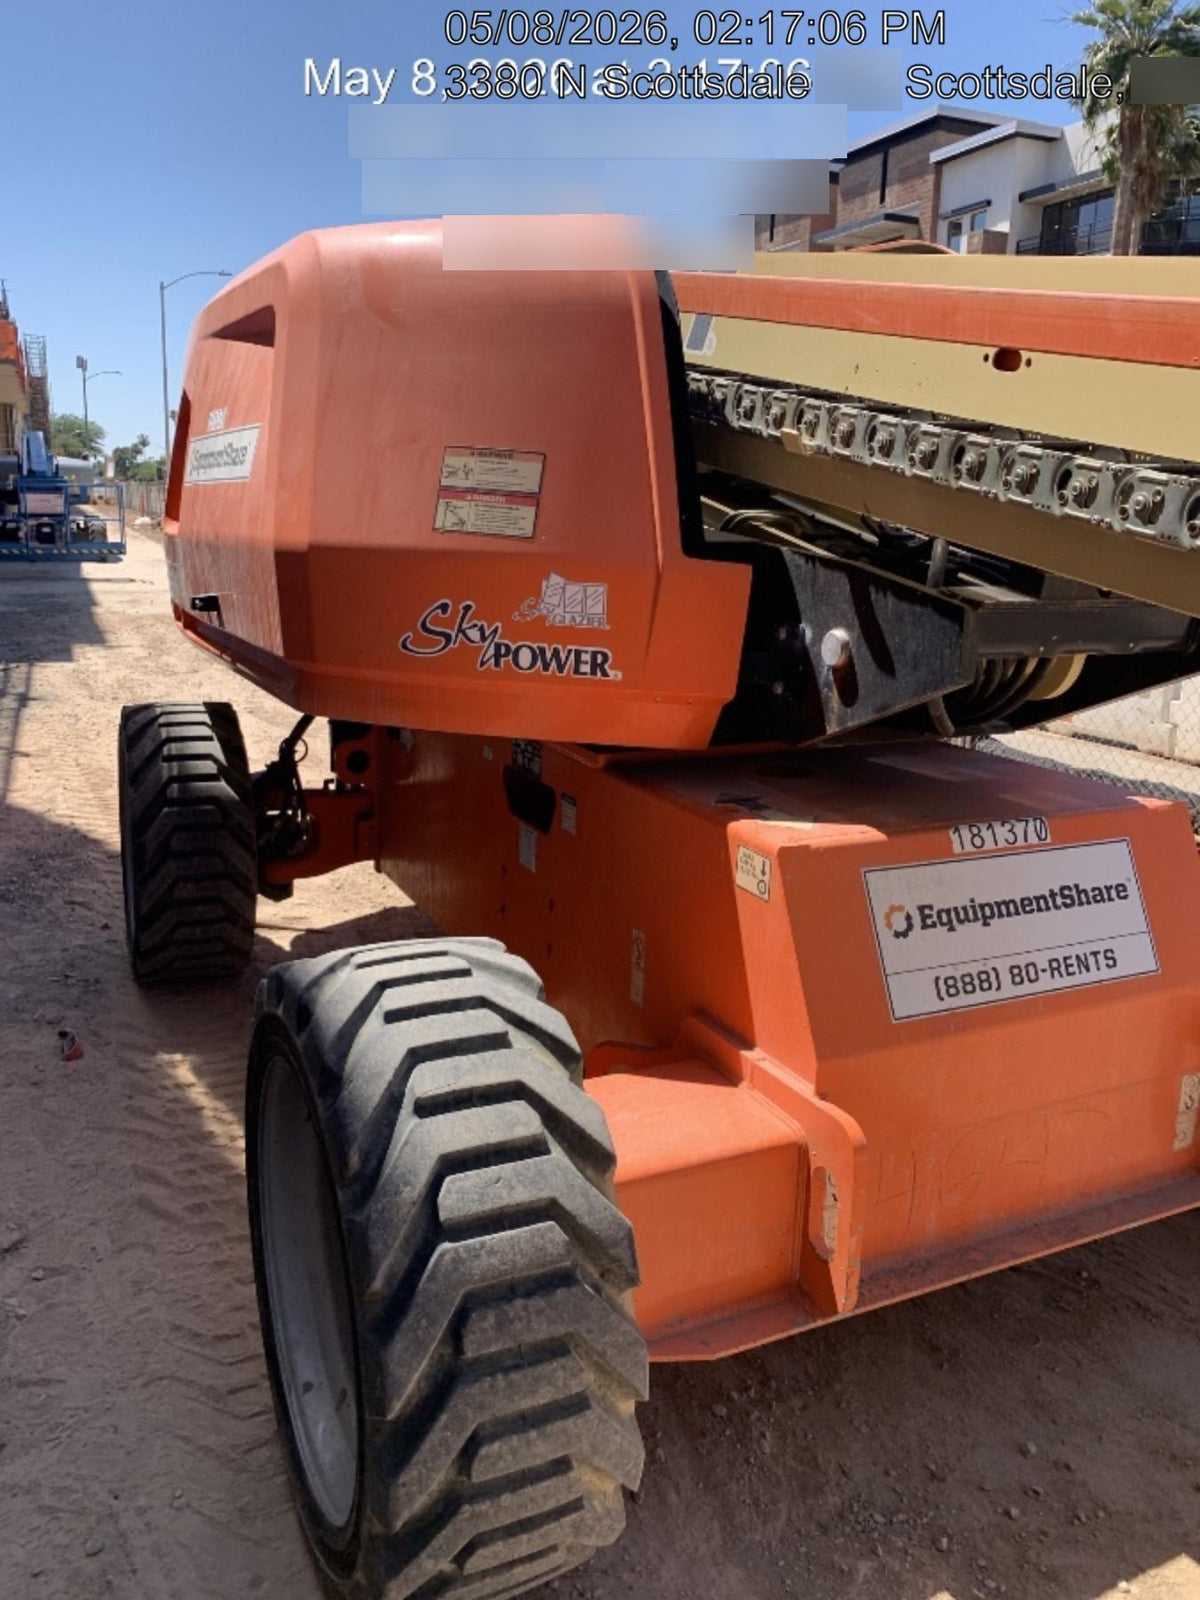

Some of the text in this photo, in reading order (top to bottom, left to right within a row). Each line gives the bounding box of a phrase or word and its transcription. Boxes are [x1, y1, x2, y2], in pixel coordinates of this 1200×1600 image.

[952, 816, 1049, 850] 181370
[916, 882, 1130, 933] EquipmentShare
[933, 948, 1118, 1002] (888) 80-RENTS
